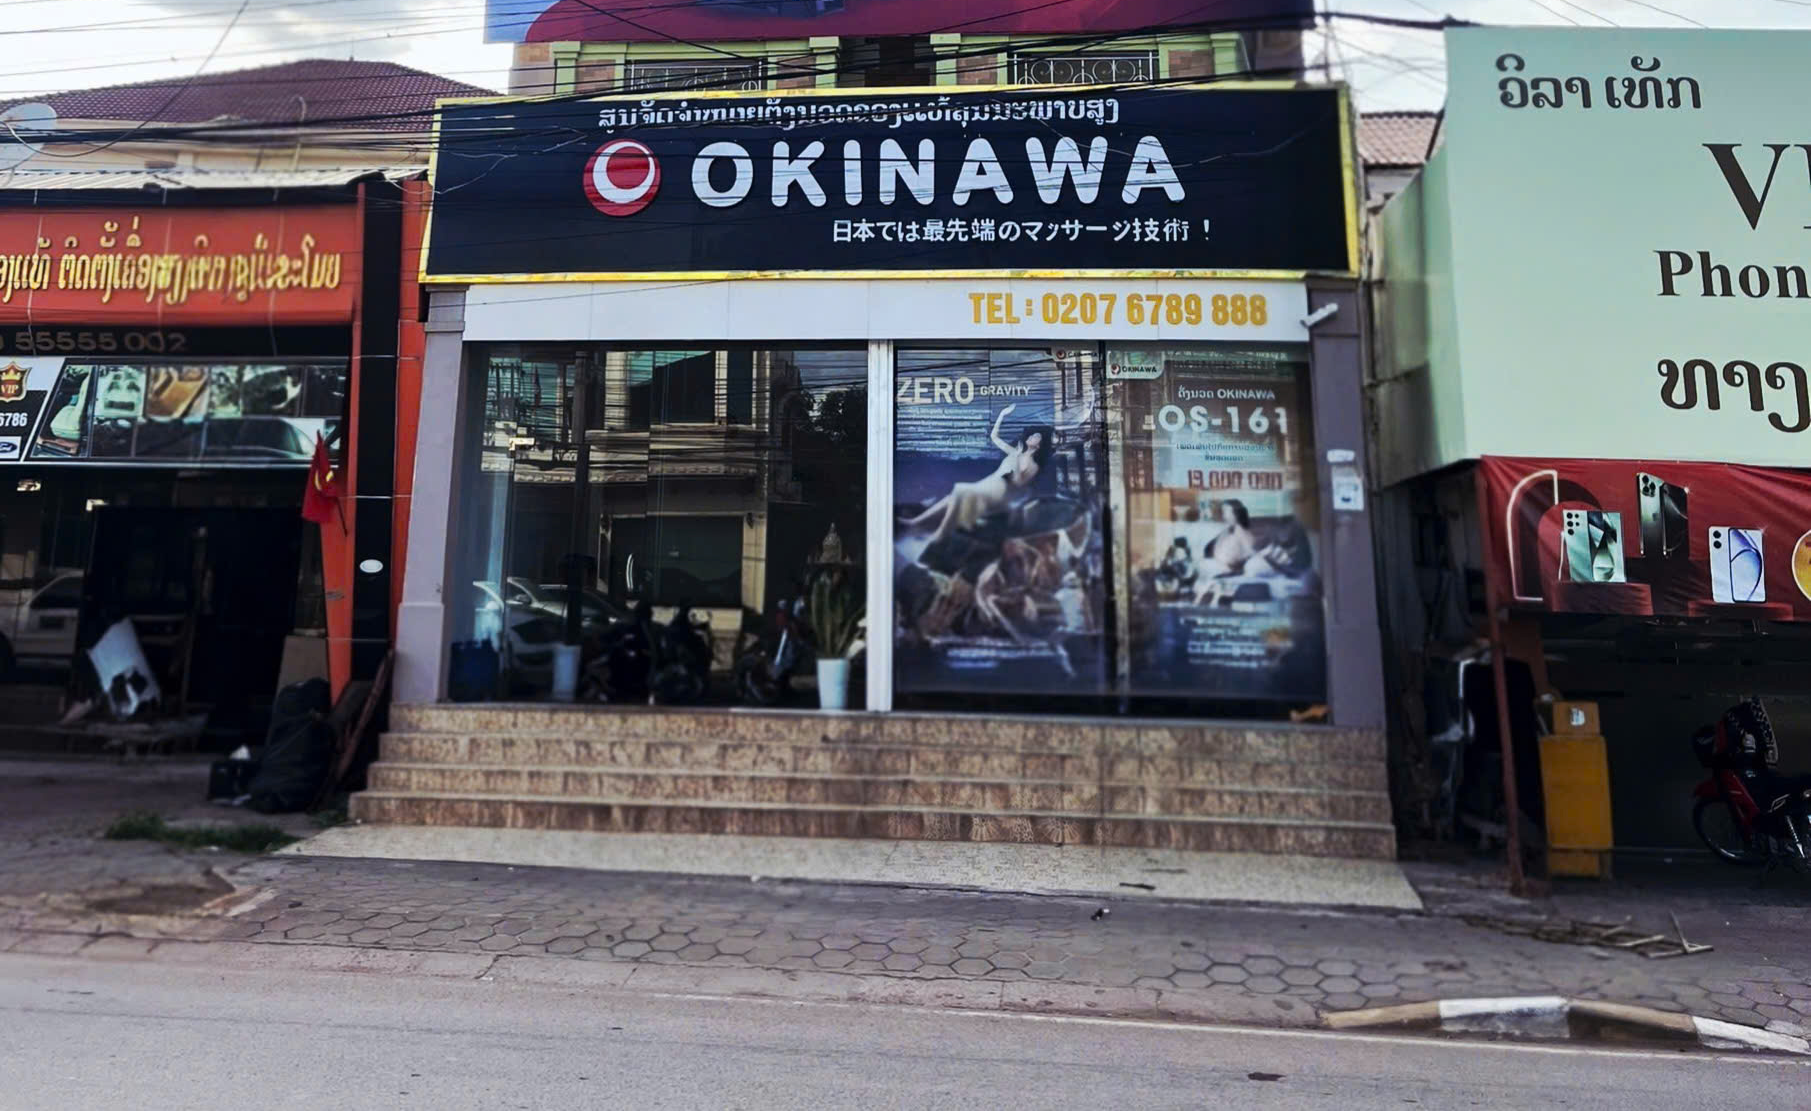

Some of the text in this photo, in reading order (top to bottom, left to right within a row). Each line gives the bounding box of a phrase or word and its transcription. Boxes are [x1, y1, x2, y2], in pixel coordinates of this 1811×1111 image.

[1496, 53, 1702, 109] ວິລາ ເທັກ
[691, 135, 1186, 207] OKINAWA
[1702, 143, 1811, 231] V
[1041, 292, 1117, 325] 0207
[1125, 293, 1201, 326] 6789
[1211, 294, 1267, 326] 888
[16, 331, 117, 352] 55555
[124, 331, 188, 353] 002
[1121, 366, 1157, 374] OKINAWA
[897, 377, 1031, 405] ZERO GRAVITY
[1217, 388, 1276, 400] OKINAWA
[1158, 404, 1288, 434] OS-161
